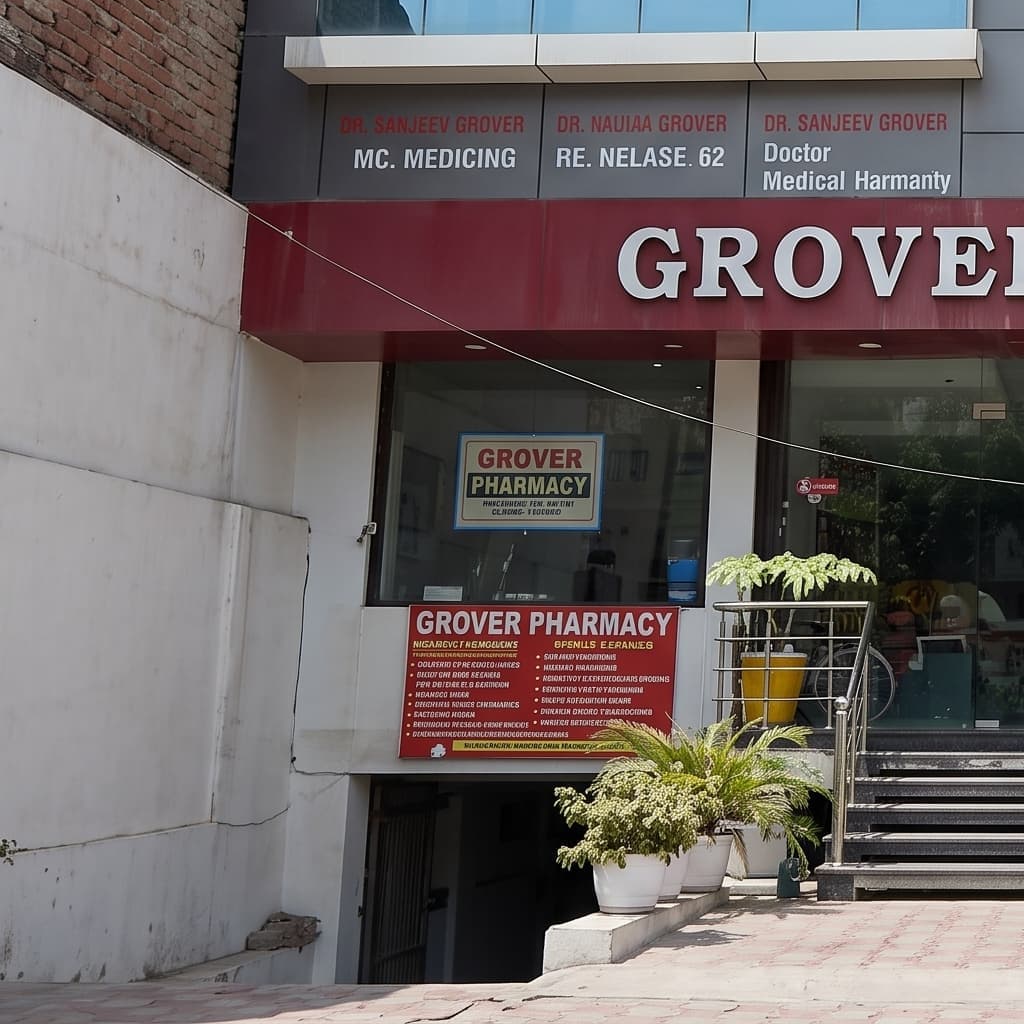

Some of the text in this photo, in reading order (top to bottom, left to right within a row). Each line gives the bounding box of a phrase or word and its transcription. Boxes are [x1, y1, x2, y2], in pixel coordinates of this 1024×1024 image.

[340, 115, 524, 134] DR. SANJEEV GROVER
[557, 115, 585, 132] DR.
[658, 113, 726, 132] GROVER
[764, 113, 947, 132] DR. SANJEEV GROVER
[354, 148, 515, 169] MC. MEDICING
[557, 148, 591, 167] RE.
[699, 147, 724, 166] 62
[765, 143, 831, 162] Doctor
[764, 171, 844, 190] Medical
[477, 448, 582, 469] GROVER
[471, 476, 588, 495] PHARMACY
[417, 611, 672, 636] GROVER PHARMACY
